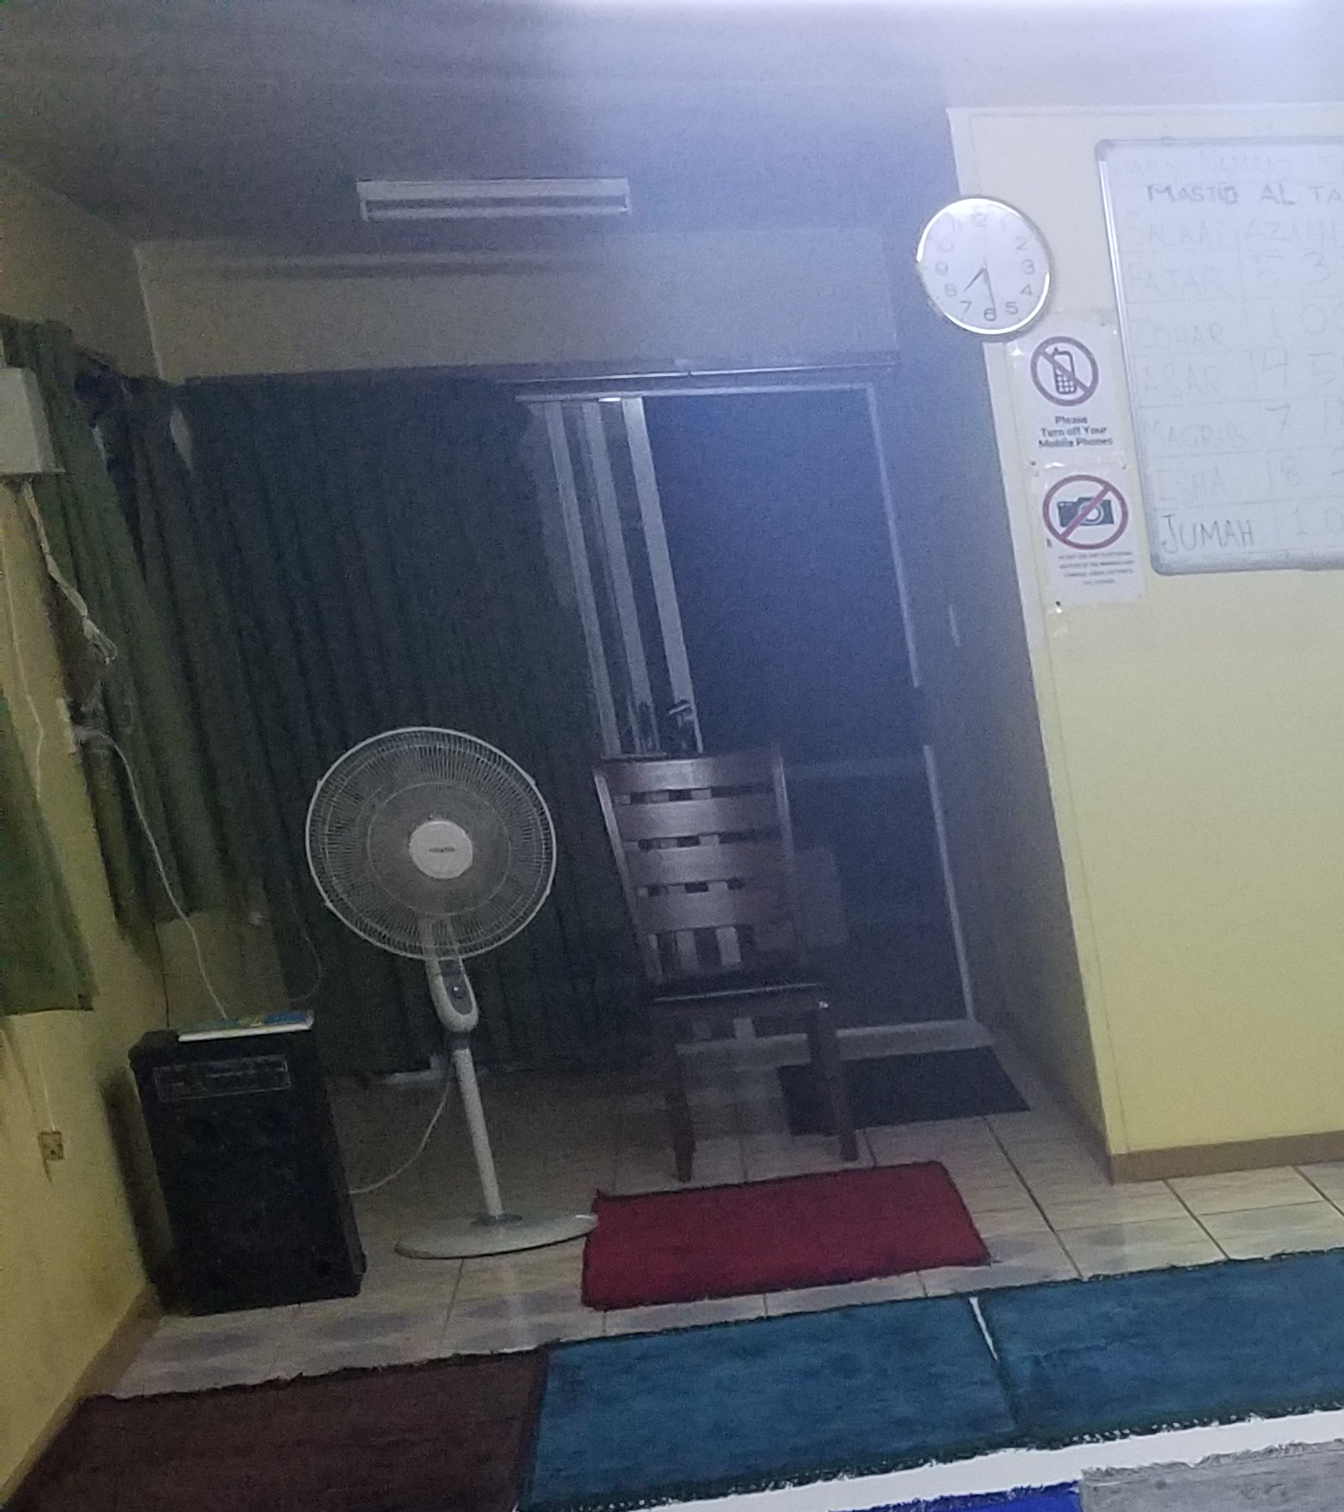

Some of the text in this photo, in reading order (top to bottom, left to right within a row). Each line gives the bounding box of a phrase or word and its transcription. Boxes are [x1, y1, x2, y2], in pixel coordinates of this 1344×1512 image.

[1260, 184, 1297, 206] AL
[1021, 259, 1035, 275] 3
[1021, 283, 1034, 296] 4
[960, 300, 972, 314] 7
[1005, 301, 1019, 315] 5
[983, 308, 997, 322] 6
[1041, 427, 1065, 438] Turn
[1066, 425, 1081, 436] off
[1161, 512, 1255, 553] JUMAH
